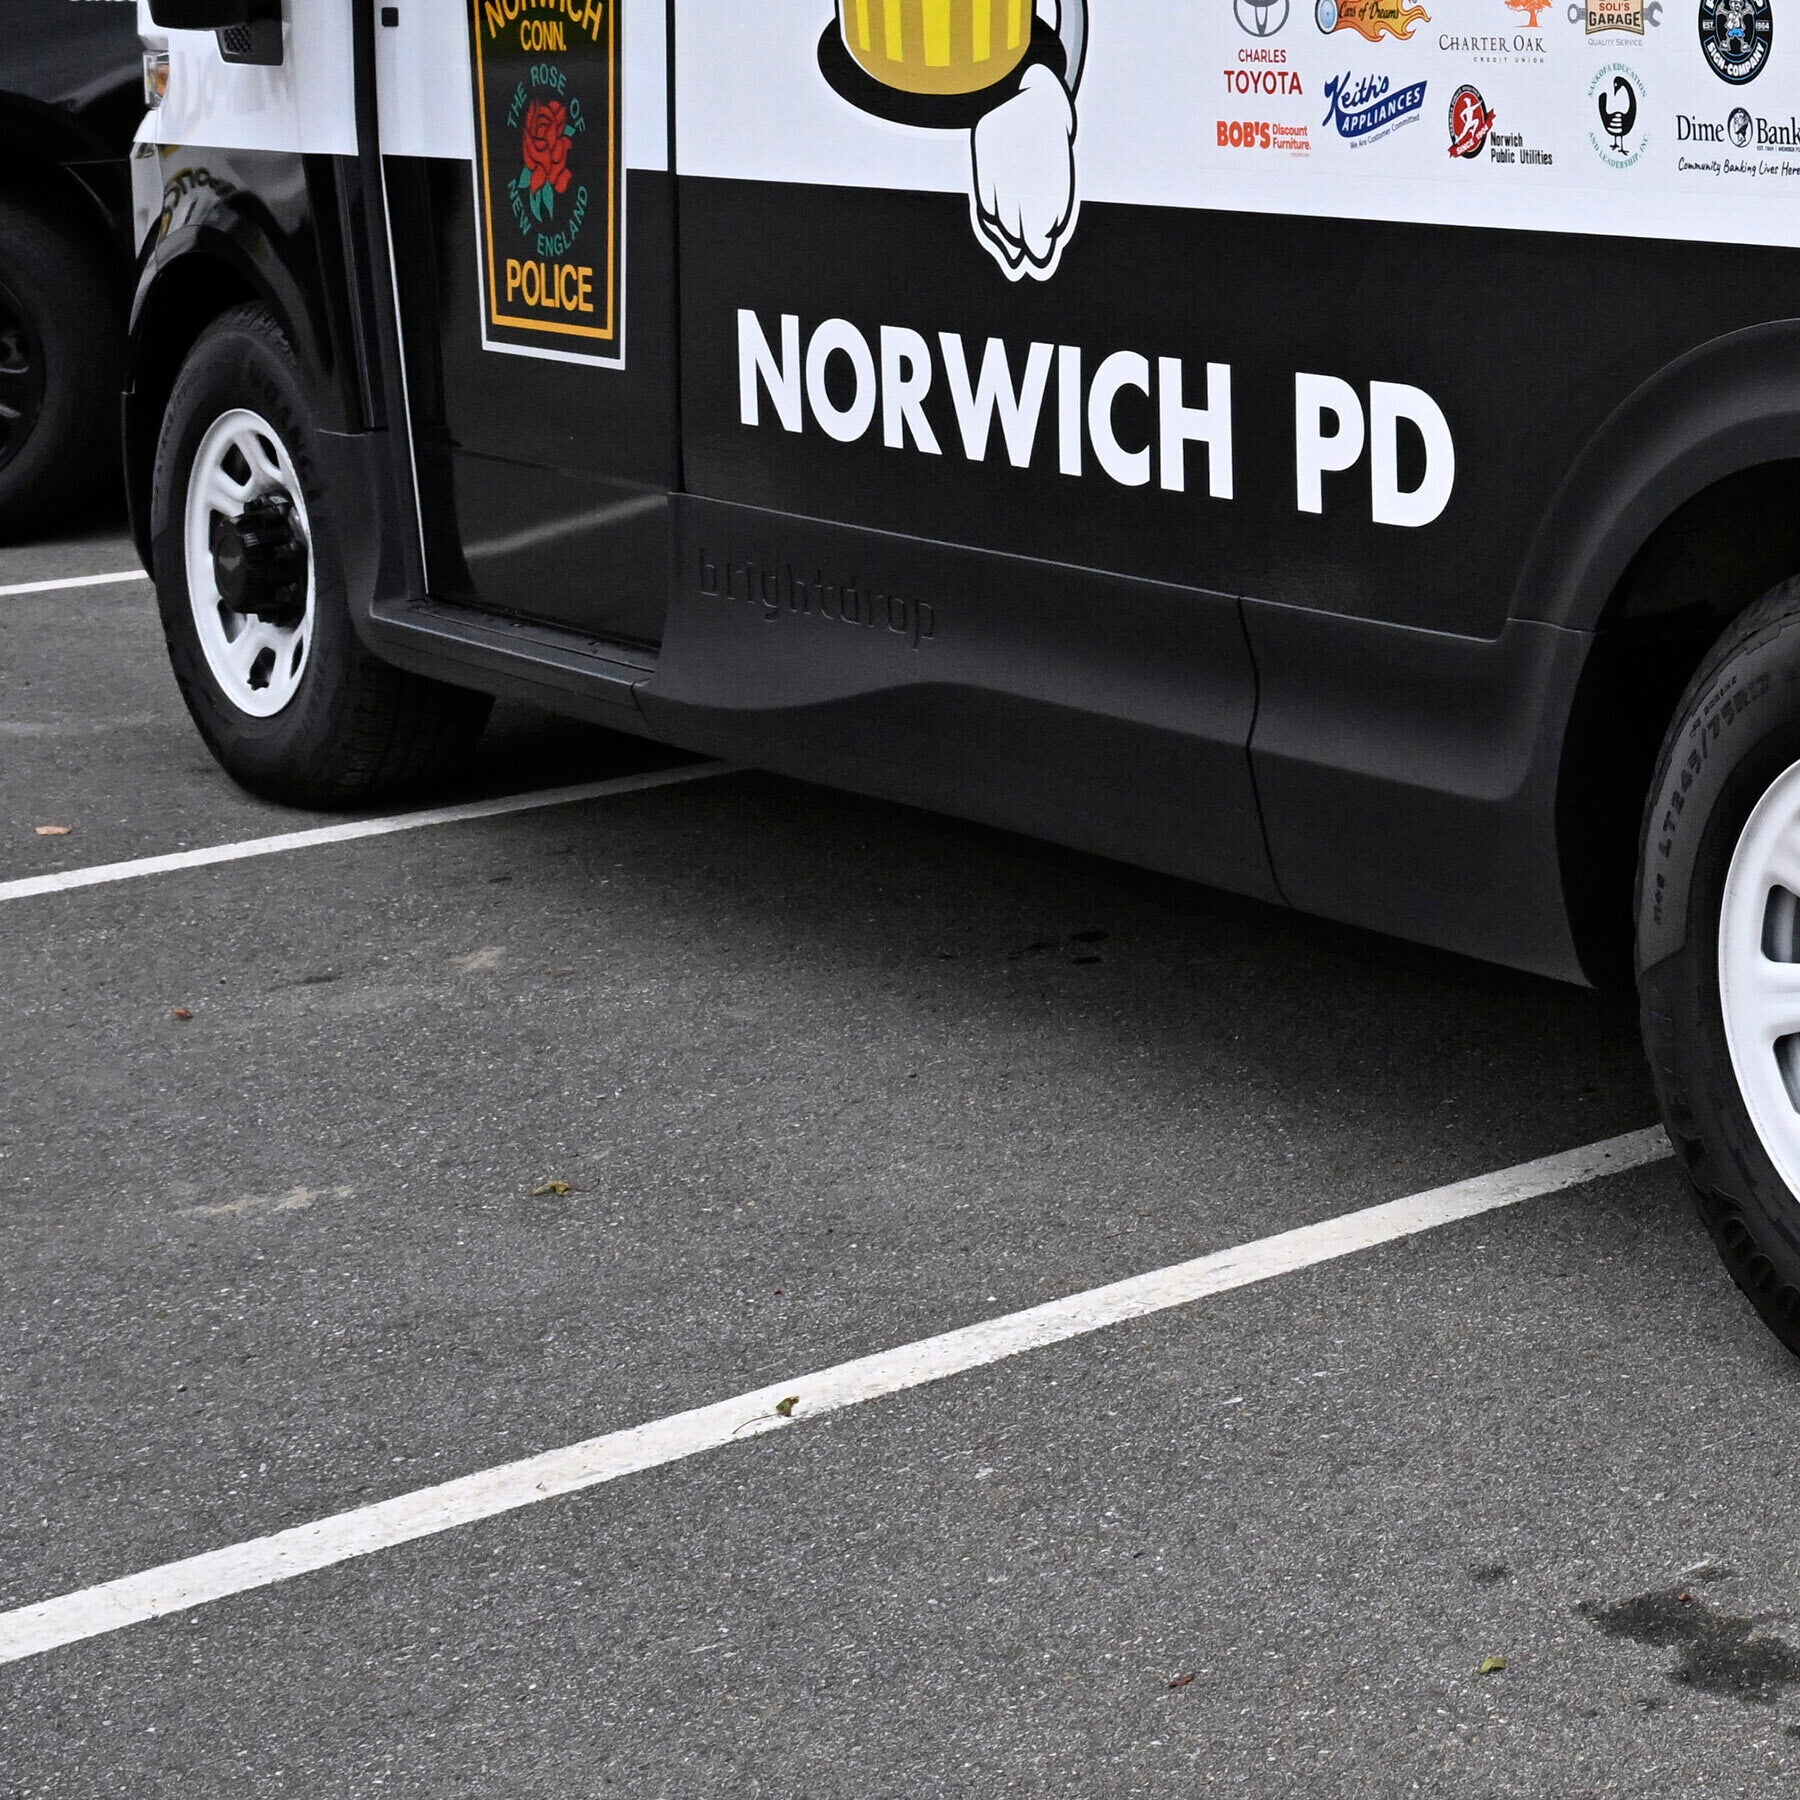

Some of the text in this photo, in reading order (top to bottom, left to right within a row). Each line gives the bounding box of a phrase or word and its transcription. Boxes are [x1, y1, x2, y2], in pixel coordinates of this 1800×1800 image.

[1589, 11, 1641, 28] GARAGE
[1598, 2, 1631, 12] SOLI'S
[520, 20, 567, 51] CONN.
[1238, 49, 1287, 63] CHARLES
[1223, 70, 1304, 95] TOYOTA
[506, 64, 587, 133] THE ROSE OF
[1322, 71, 1390, 127] Keith's
[1341, 86, 1422, 132] APPLIANCES
[1216, 120, 1271, 149] BOB'S
[1272, 123, 1308, 137] Discount
[1490, 131, 1524, 148] Norwich
[1676, 114, 1725, 143] Dime
[1490, 148, 1553, 165] Public Utilities
[1678, 156, 1720, 177] Community
[1723, 158, 1757, 178] Banking
[1758, 160, 1779, 176] Lives
[507, 178, 589, 257] NEW ENGLAND
[506, 258, 594, 313] POLICE
[737, 308, 1456, 528] NORWICH PD
